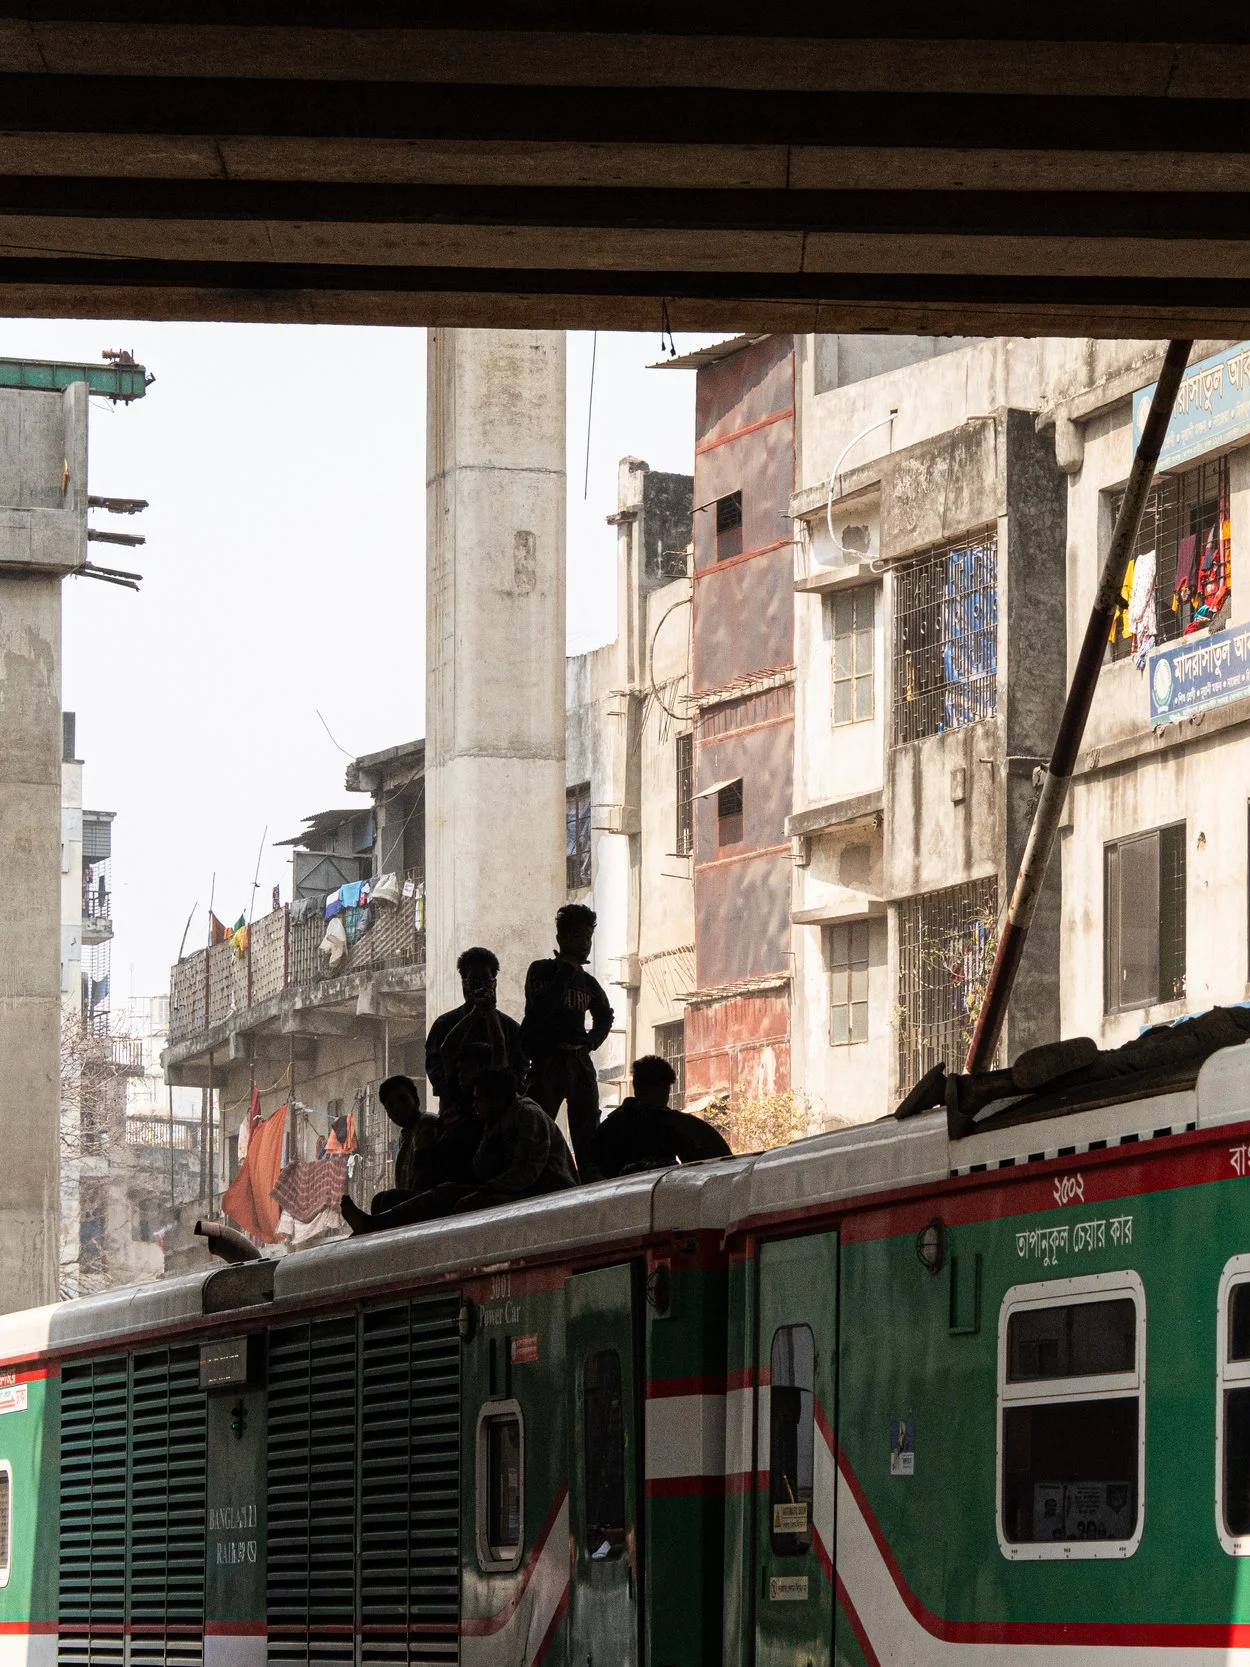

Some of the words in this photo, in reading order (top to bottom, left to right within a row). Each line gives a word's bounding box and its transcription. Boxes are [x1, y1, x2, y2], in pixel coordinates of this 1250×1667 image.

[1173, 639, 1232, 683] মাদরাসাতুল
[1052, 1172, 1085, 1207] ২৫০২
[1015, 1225, 1069, 1267] তাপানুকূল
[1072, 1217, 1106, 1252] চেয়ার
[1109, 1213, 1133, 1246] কার
[479, 1305, 503, 1327] Power
[505, 1300, 521, 1324] Car
